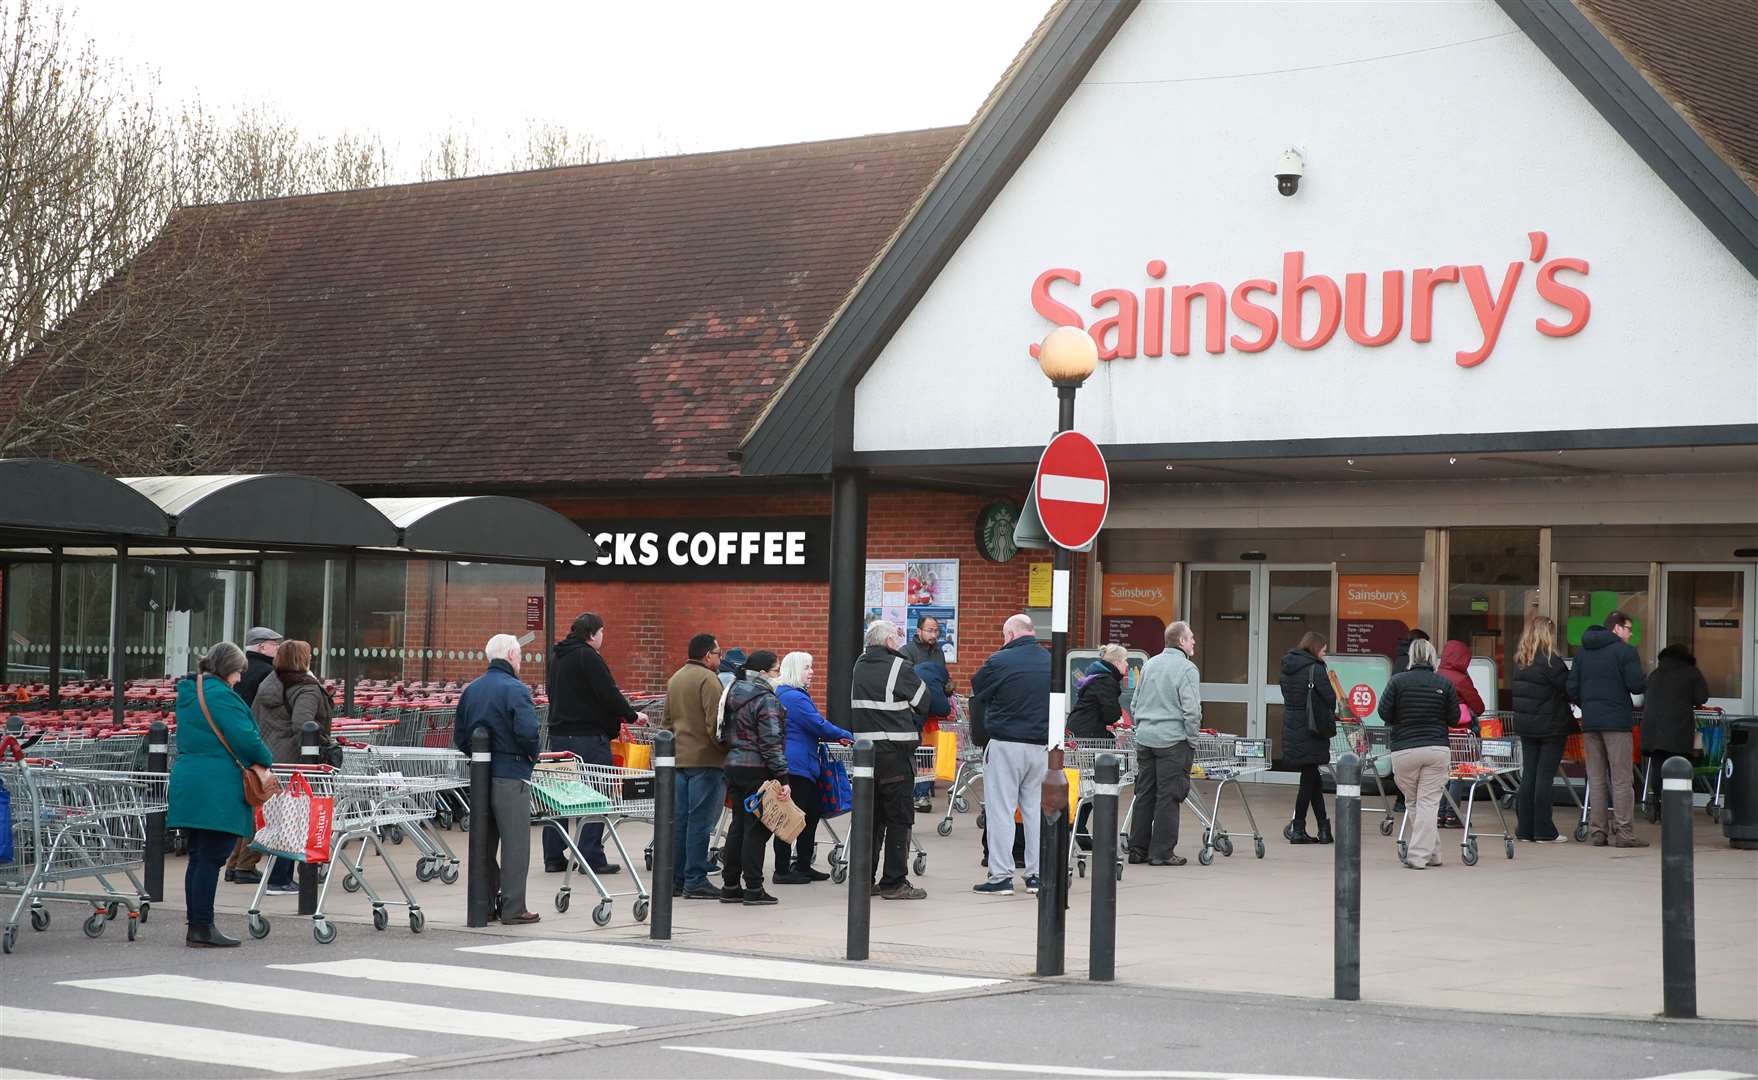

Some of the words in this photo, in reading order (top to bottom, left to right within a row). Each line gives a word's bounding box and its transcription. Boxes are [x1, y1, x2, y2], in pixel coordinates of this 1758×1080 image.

[1030, 231, 1592, 369] Sainsbury's
[667, 531, 806, 566] COFFEE
[1109, 587, 1163, 600] Sainsbury's
[1347, 588, 1409, 603] Sainsbury's
[1353, 691, 1371, 706] £9
